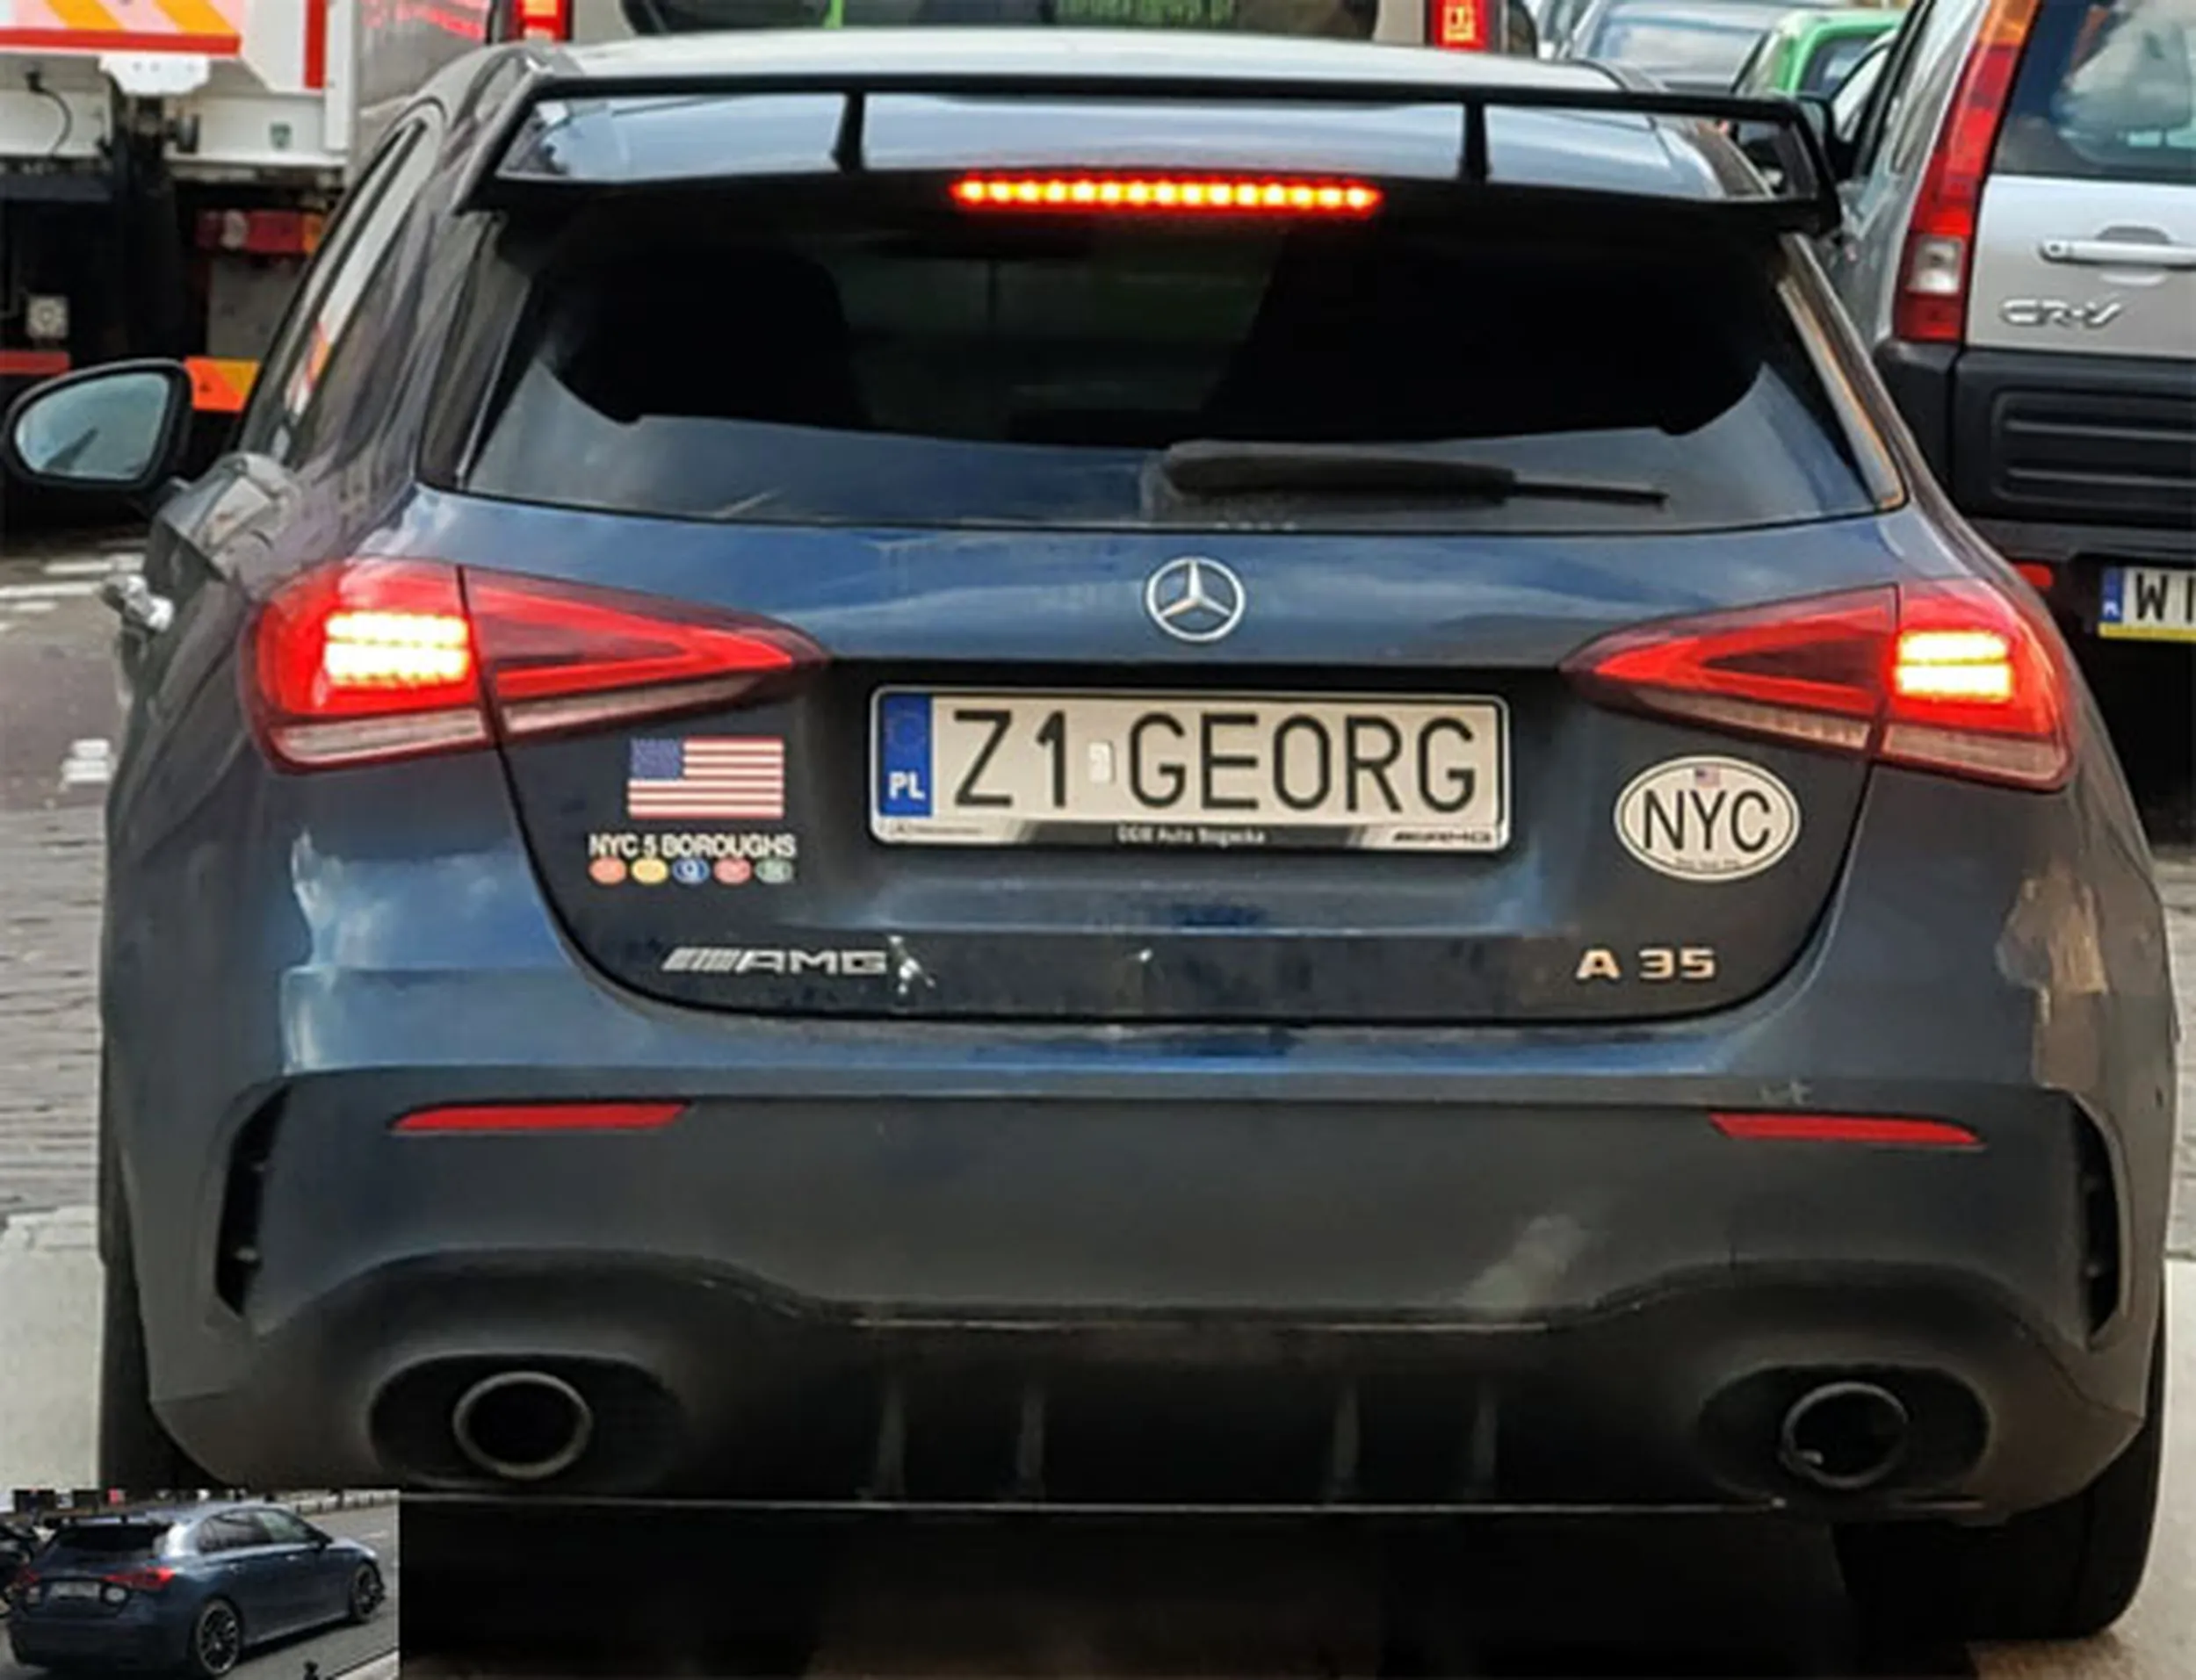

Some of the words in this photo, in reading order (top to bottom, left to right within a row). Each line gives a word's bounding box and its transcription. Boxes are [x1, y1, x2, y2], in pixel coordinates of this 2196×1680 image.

[953, 709, 1066, 808] Z1
[1127, 712, 1476, 813] GEORG
[889, 771, 925, 800] PL
[1643, 790, 1771, 852] NYC
[589, 833, 639, 857] NYC
[643, 833, 659, 857] 5
[661, 833, 798, 858] BOROUGHS
[736, 948, 887, 974] AMG
[1576, 948, 1620, 979] A
[1639, 948, 1716, 979] 35
